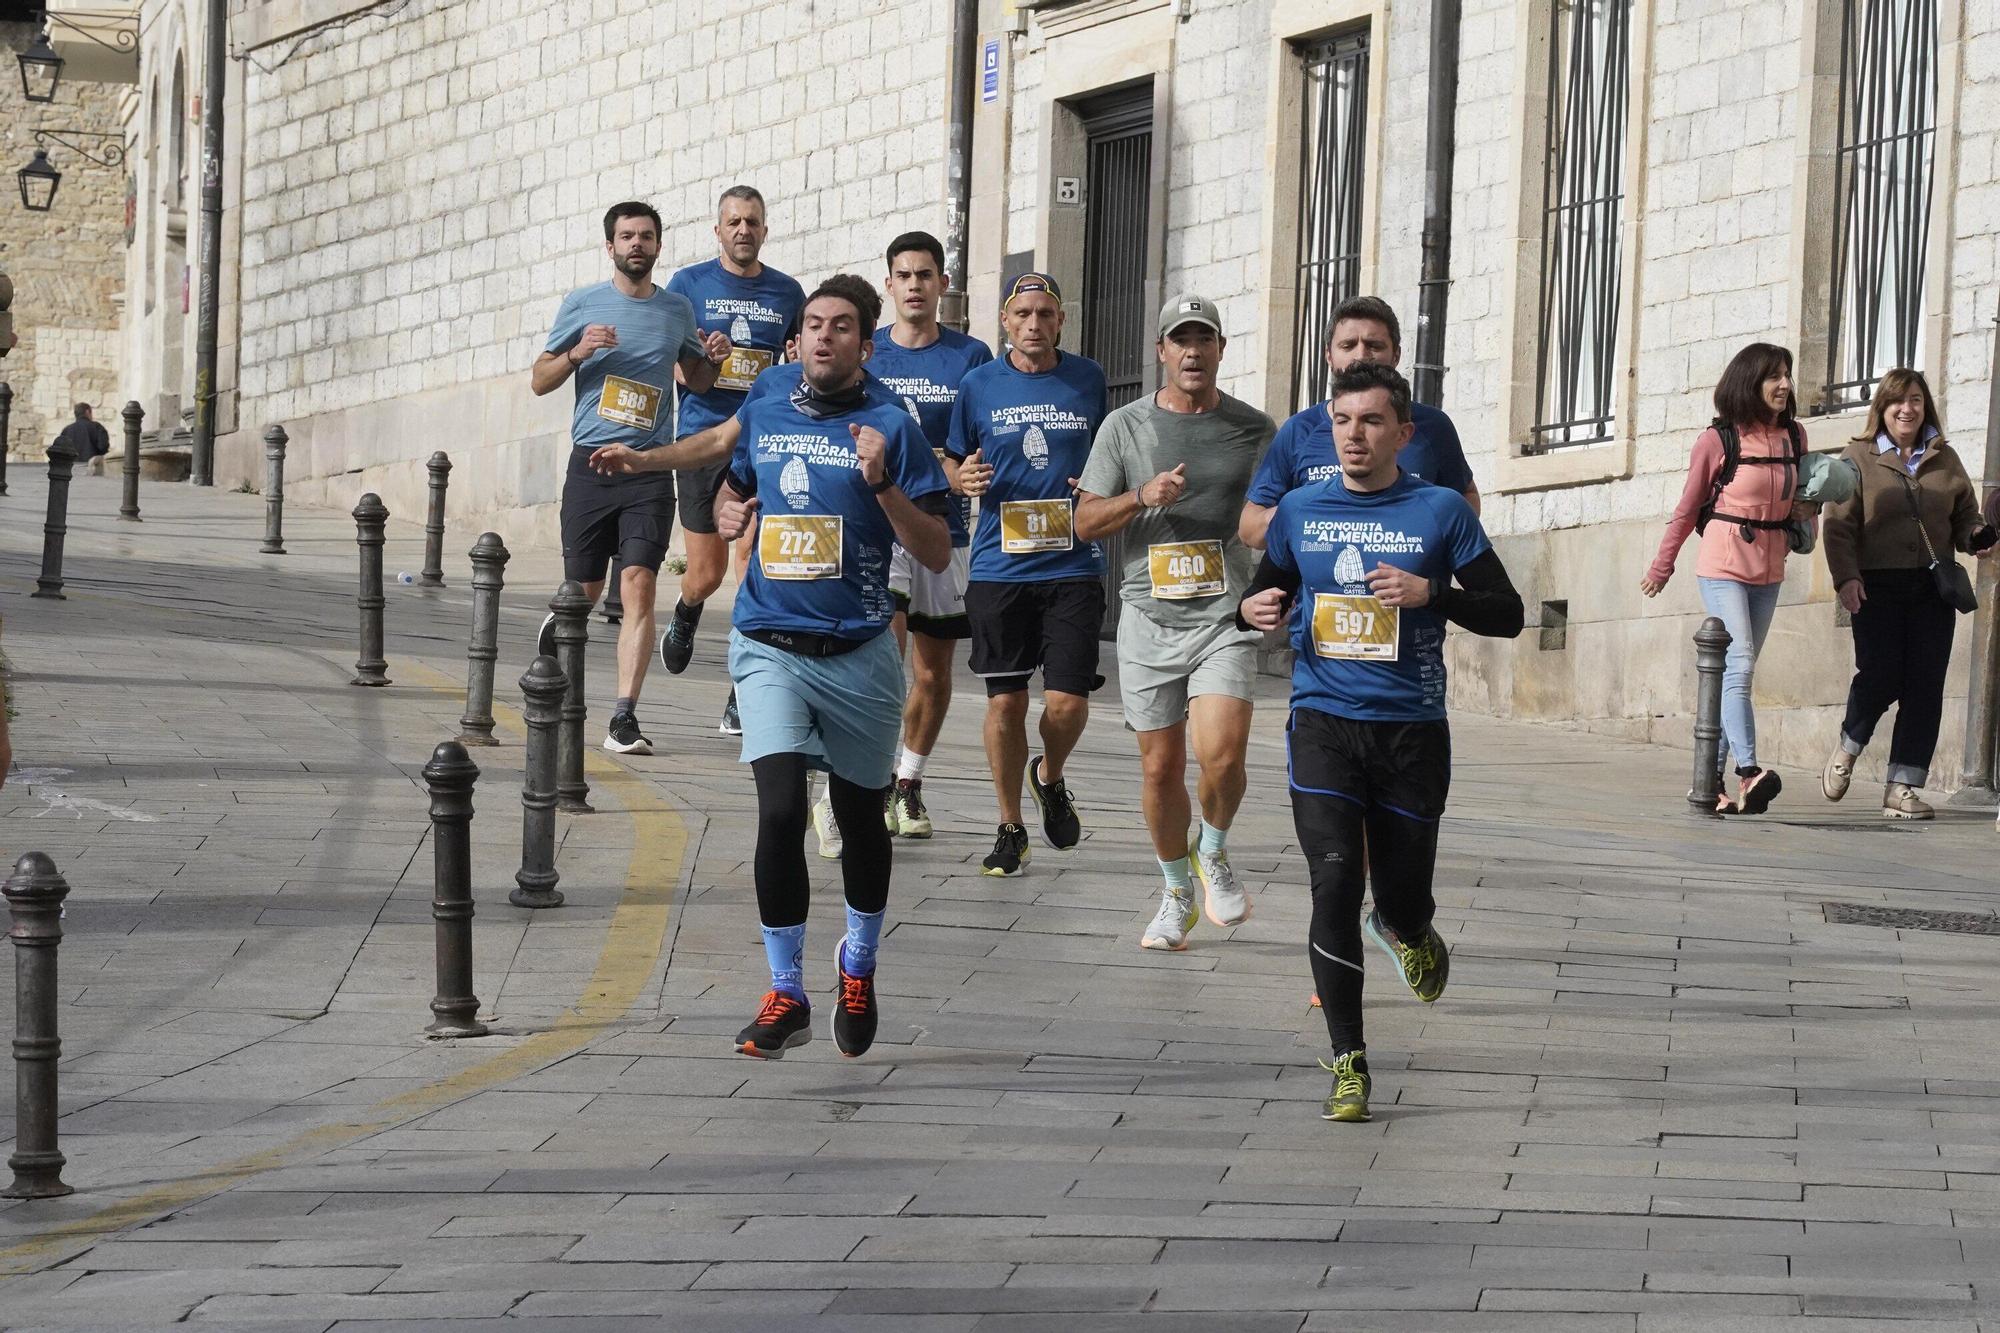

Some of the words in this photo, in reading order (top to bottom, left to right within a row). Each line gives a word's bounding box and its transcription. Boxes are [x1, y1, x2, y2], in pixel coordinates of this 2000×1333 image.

[716, 299, 759, 307] CONQUISTA
[718, 306, 774, 316] ALMENDRA
[748, 314, 783, 325] KONKISTA
[731, 358, 760, 376] 562
[889, 385, 949, 395] MENDRA
[617, 389, 648, 412] 588
[917, 395, 956, 403] KONKIST
[992, 409, 1002, 417] LA
[1003, 404, 1057, 416] CONQUISTA
[1005, 412, 1077, 425] ALMENDRA
[1044, 422, 1088, 430] KONKISTA
[759, 434, 769, 442] LA
[769, 434, 829, 444] CONQUISTA
[768, 442, 849, 458] ALMENDRA
[1308, 467, 1319, 476] LA
[1027, 513, 1048, 533] 81
[1304, 521, 1316, 529] LA
[1318, 521, 1383, 532] CONQUISTA
[780, 531, 816, 555] 272
[1317, 531, 1406, 543] ALMENDRA
[1363, 543, 1424, 553] KONKISTA
[1168, 555, 1206, 577] 460
[1335, 611, 1375, 636] 597
[770, 632, 792, 645] FILA
